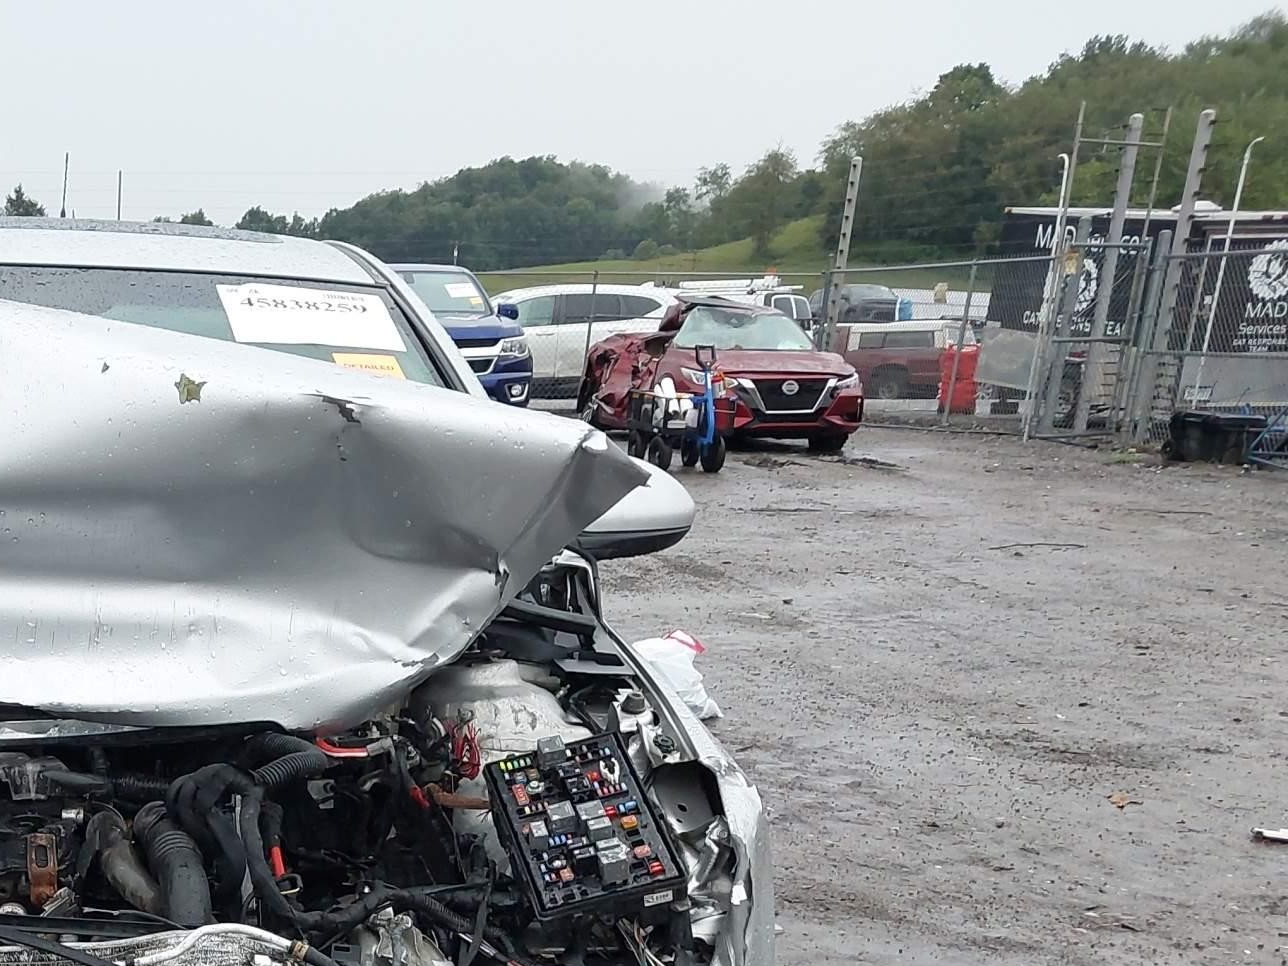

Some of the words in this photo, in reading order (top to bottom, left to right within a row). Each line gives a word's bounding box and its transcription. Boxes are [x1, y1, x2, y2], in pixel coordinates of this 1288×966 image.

[239, 297, 368, 314] 45838259
[1245, 301, 1288, 318] MAD
[1238, 322, 1288, 334] Services
